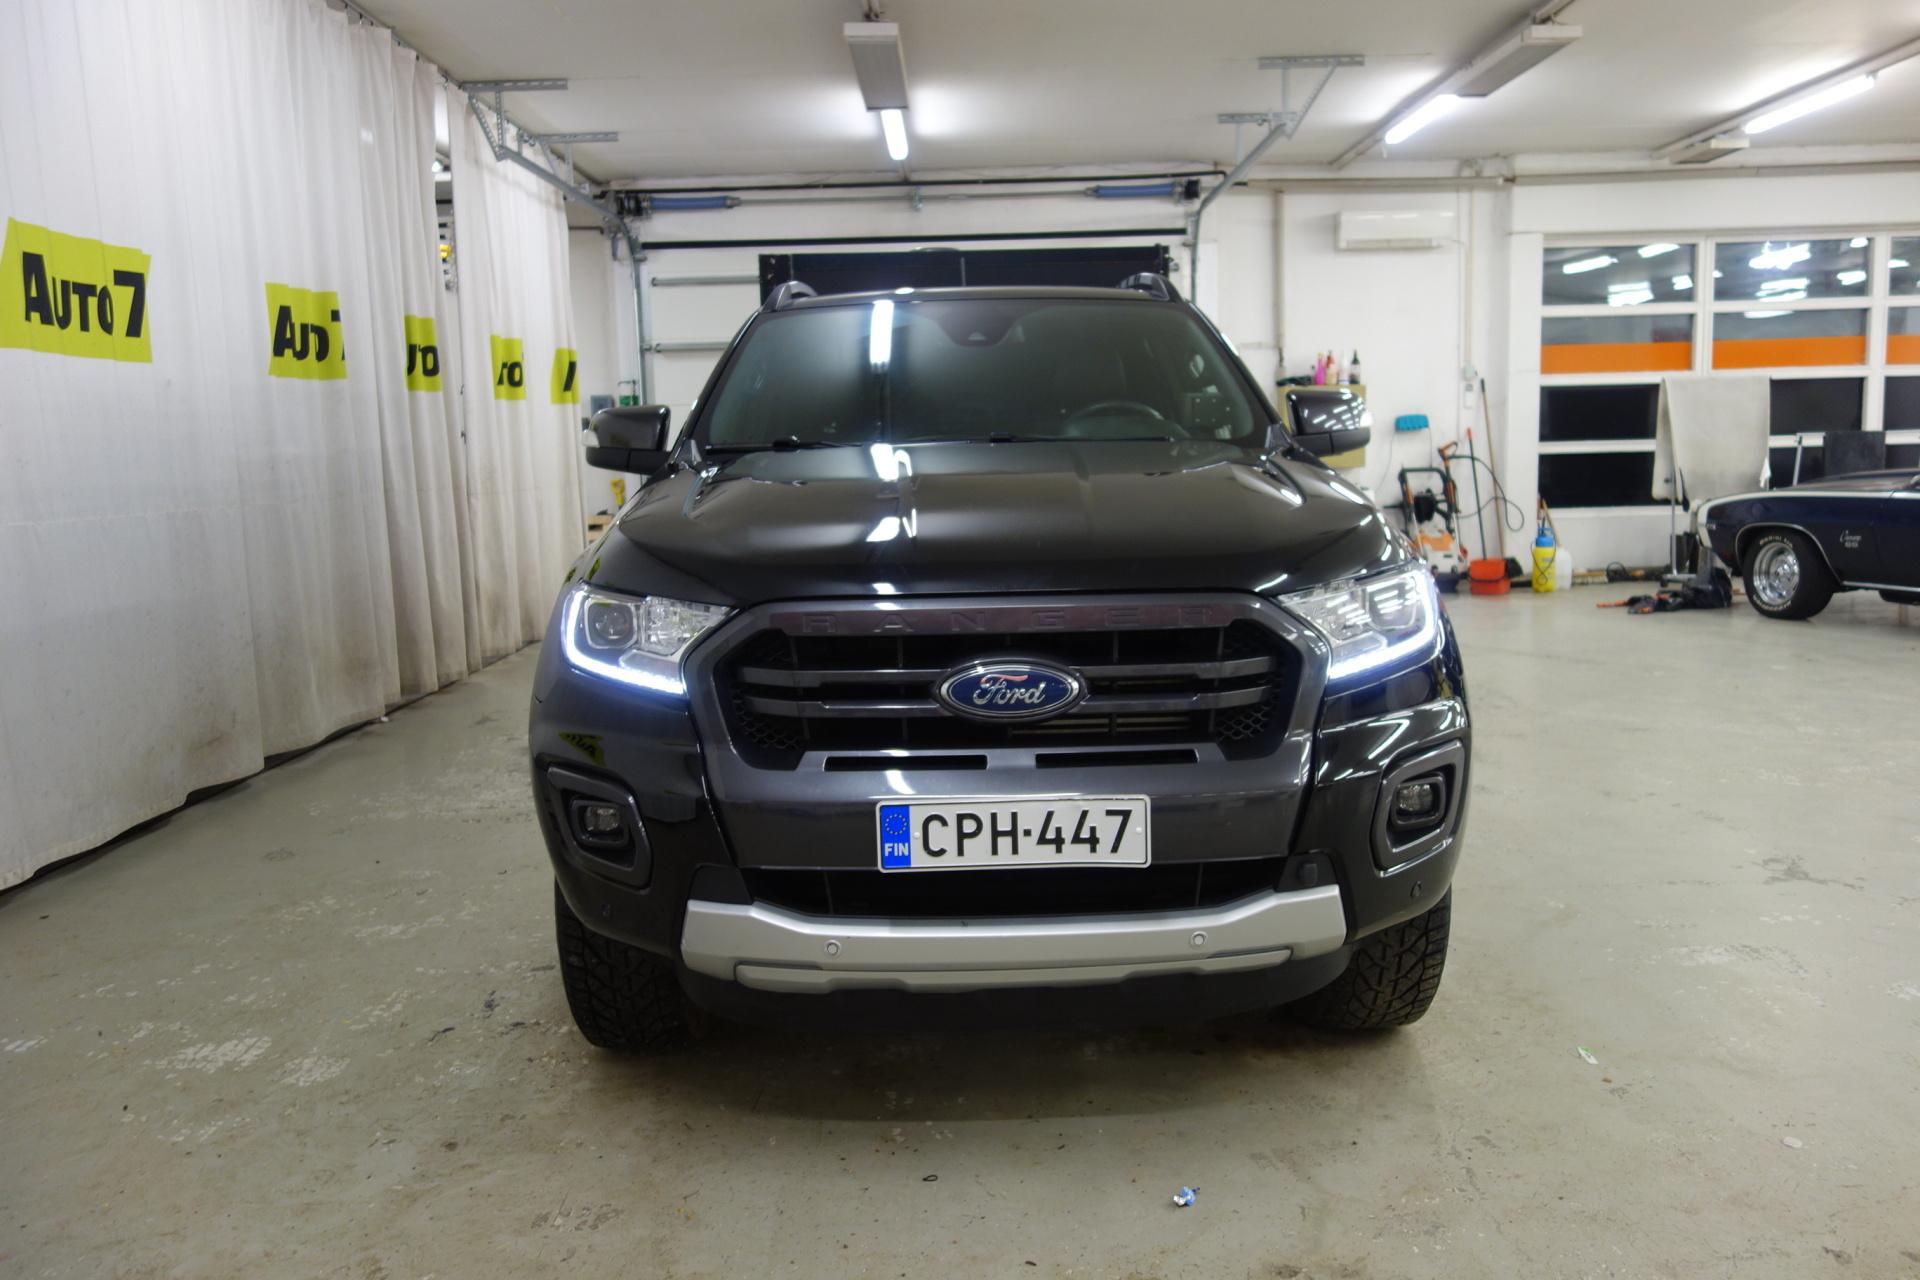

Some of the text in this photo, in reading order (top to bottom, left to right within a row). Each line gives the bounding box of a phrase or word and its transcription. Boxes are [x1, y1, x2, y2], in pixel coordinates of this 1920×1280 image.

[802, 606, 1213, 634] RANGER
[972, 673, 1047, 705] Ford
[884, 808, 1133, 858] FIN CPH-447
